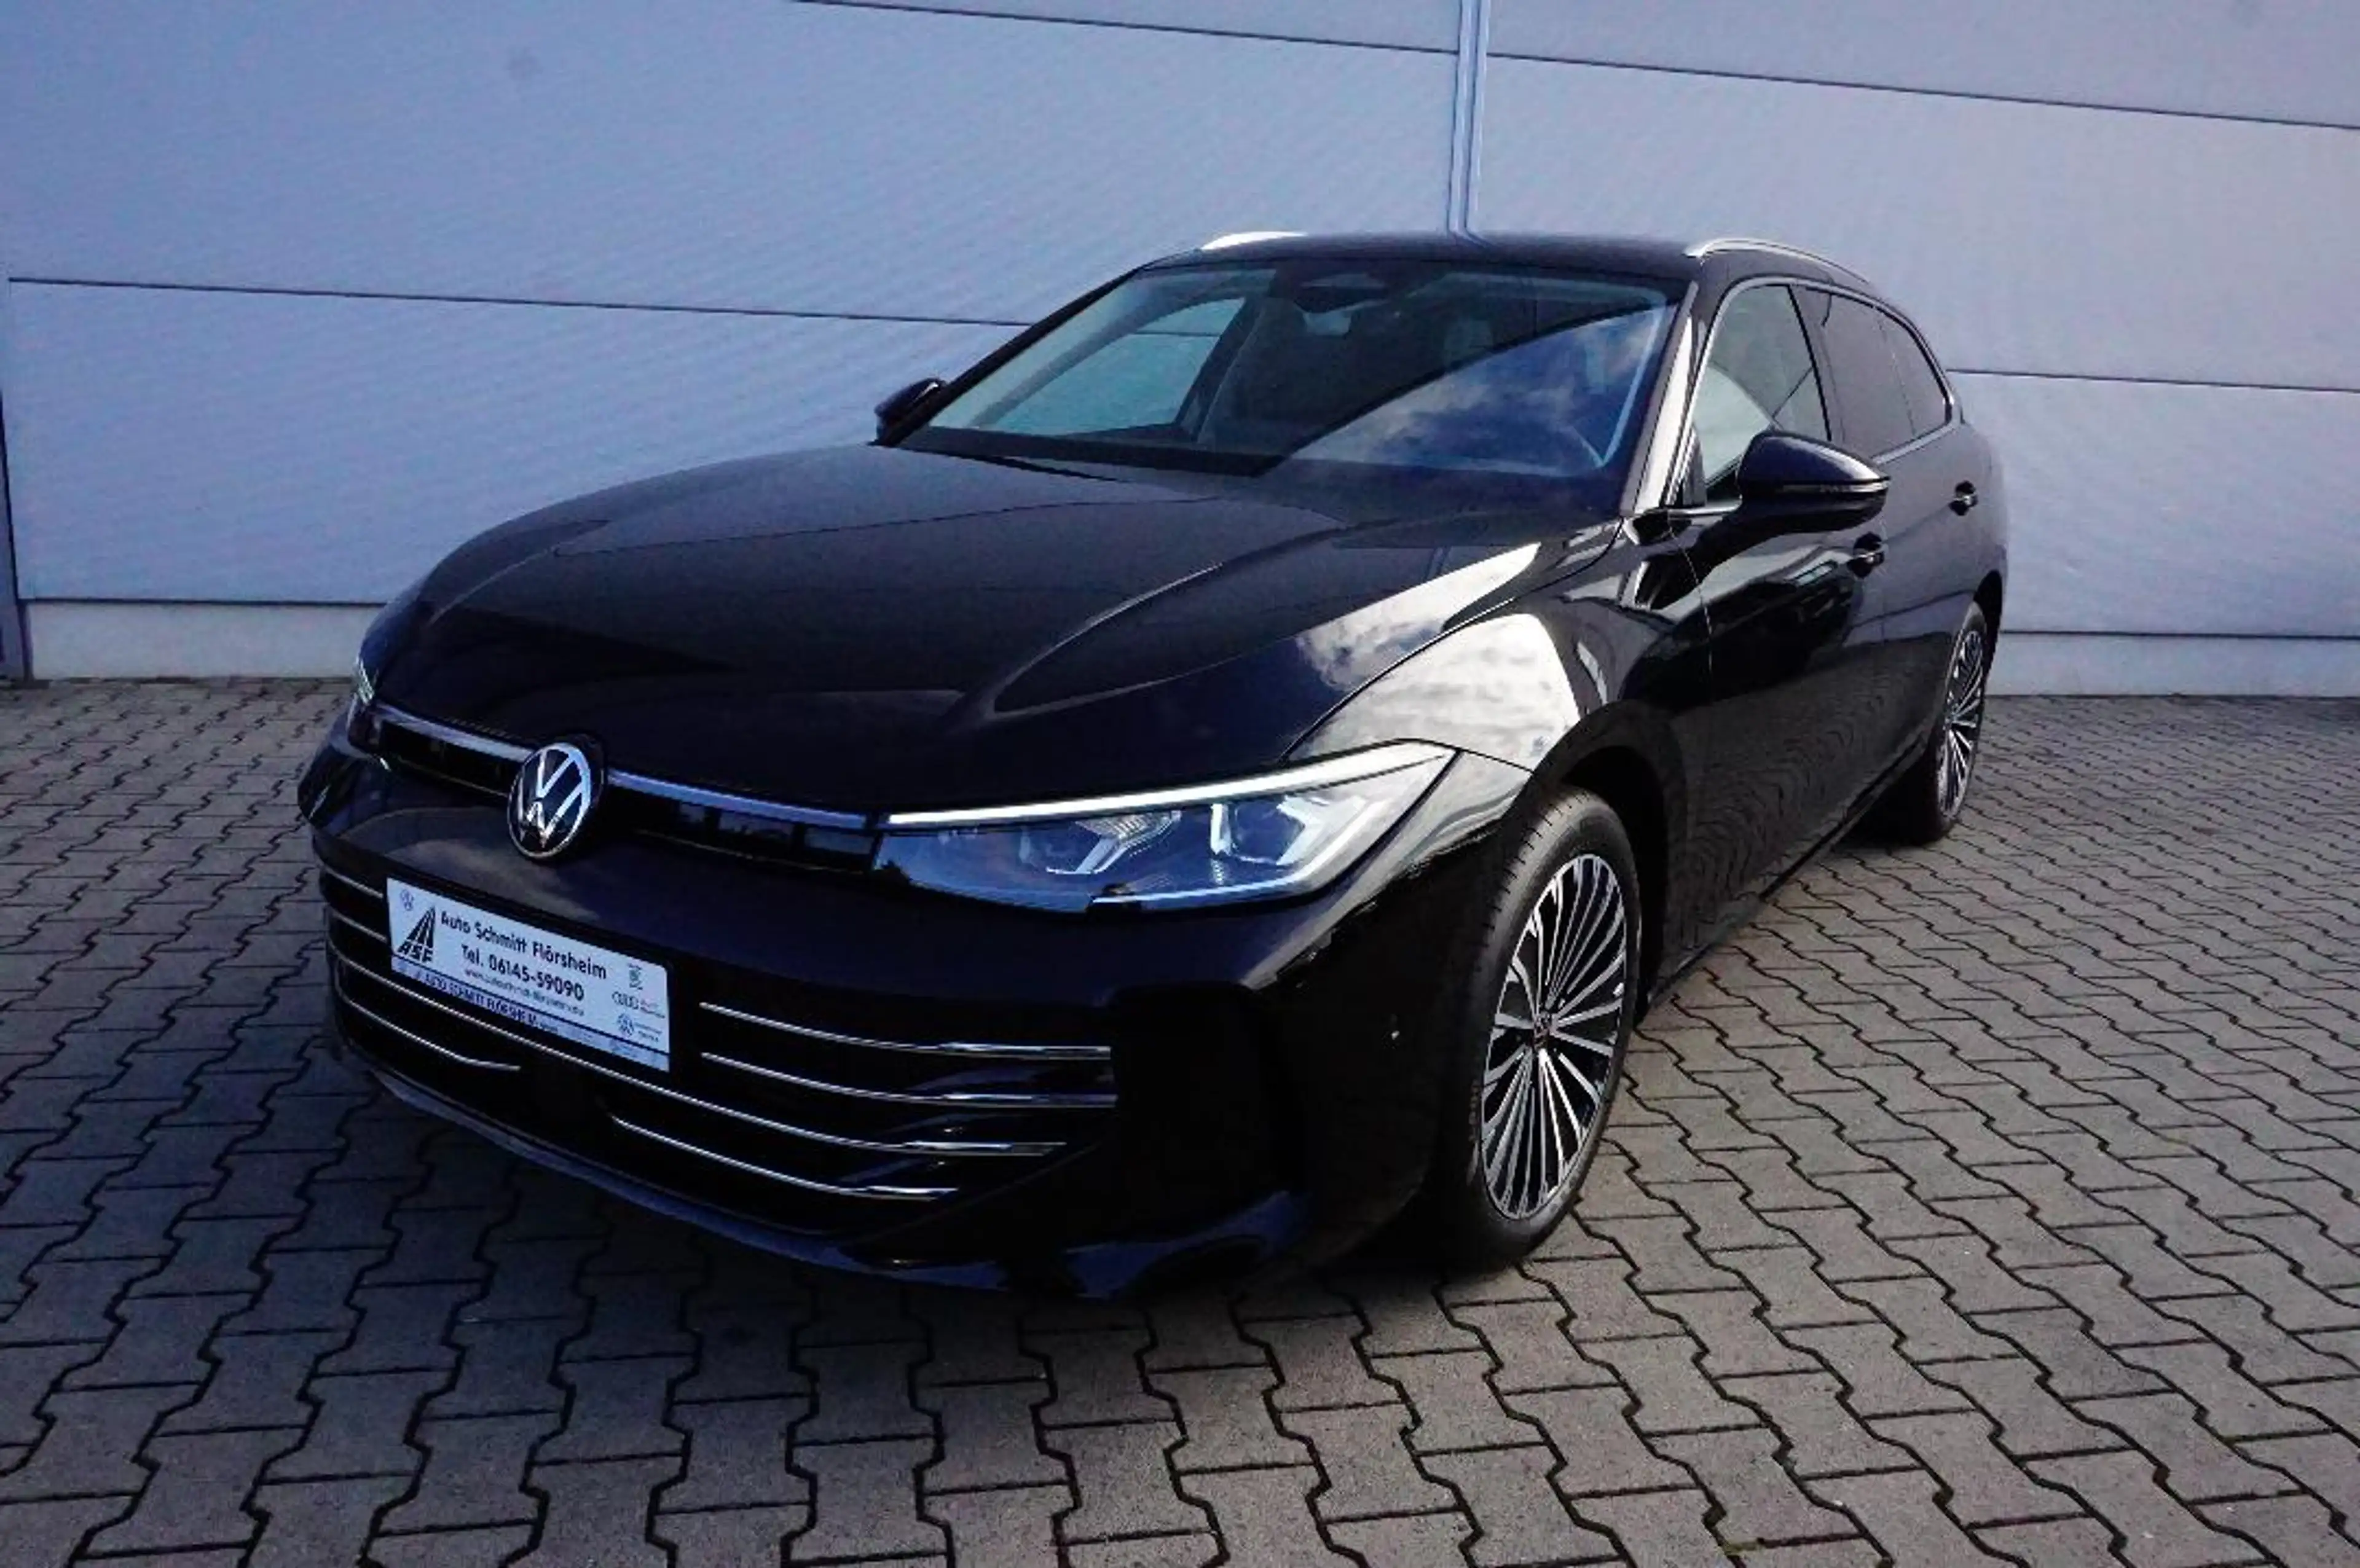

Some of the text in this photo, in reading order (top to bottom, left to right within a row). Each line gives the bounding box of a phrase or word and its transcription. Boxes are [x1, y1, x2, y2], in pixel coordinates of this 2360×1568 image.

[441, 911, 471, 934] Auto
[474, 921, 527, 953] Schmitt
[532, 941, 607, 979] Flörsheim
[462, 943, 484, 967] Tel.
[488, 954, 584, 1002] 06145-59090
